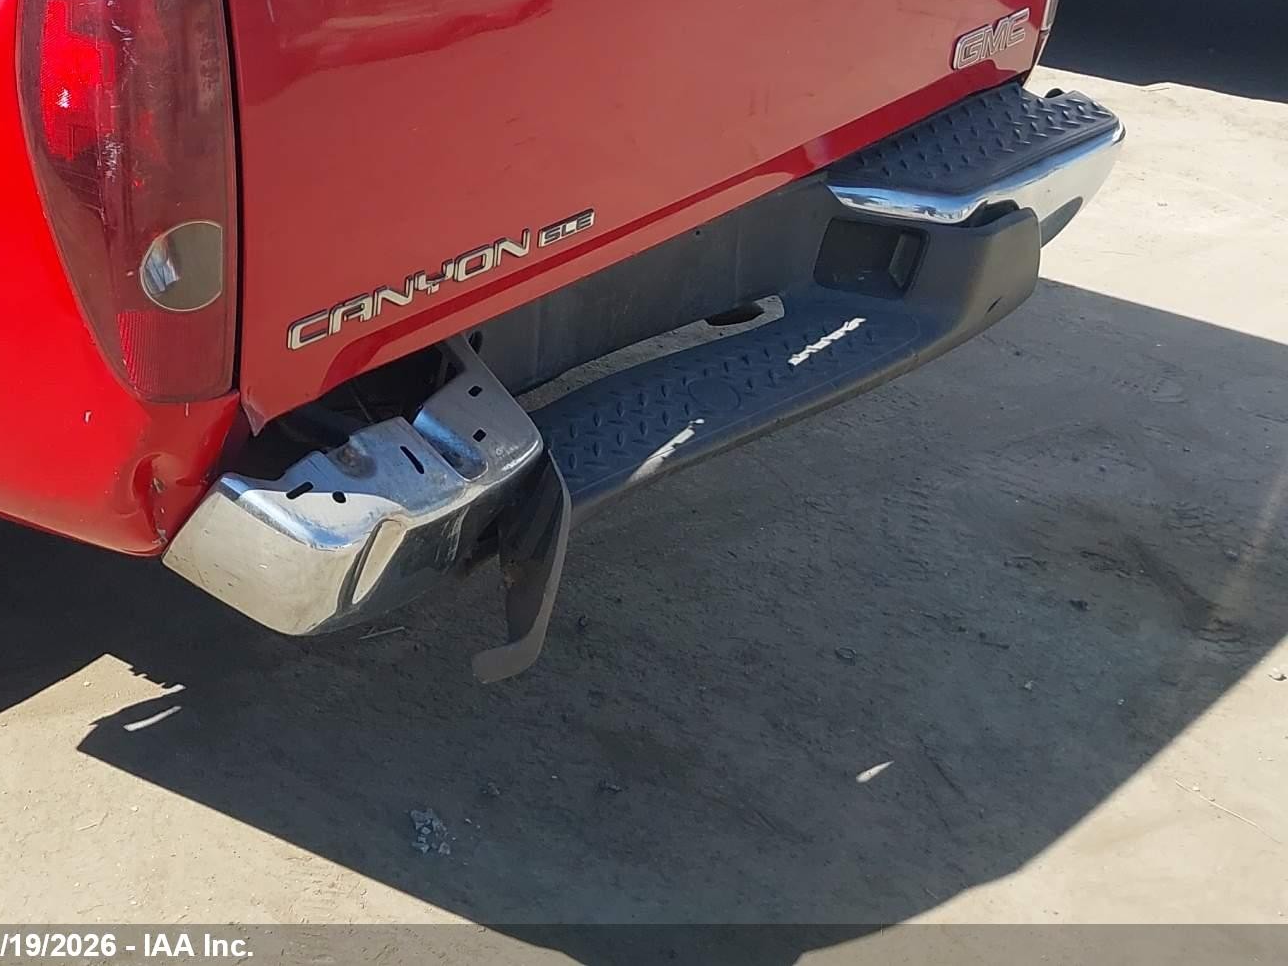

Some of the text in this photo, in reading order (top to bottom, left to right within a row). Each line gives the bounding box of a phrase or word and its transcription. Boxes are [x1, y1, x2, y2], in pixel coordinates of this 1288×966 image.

[952, 7, 1031, 70] GMC
[287, 208, 596, 352] CANYON SLE
